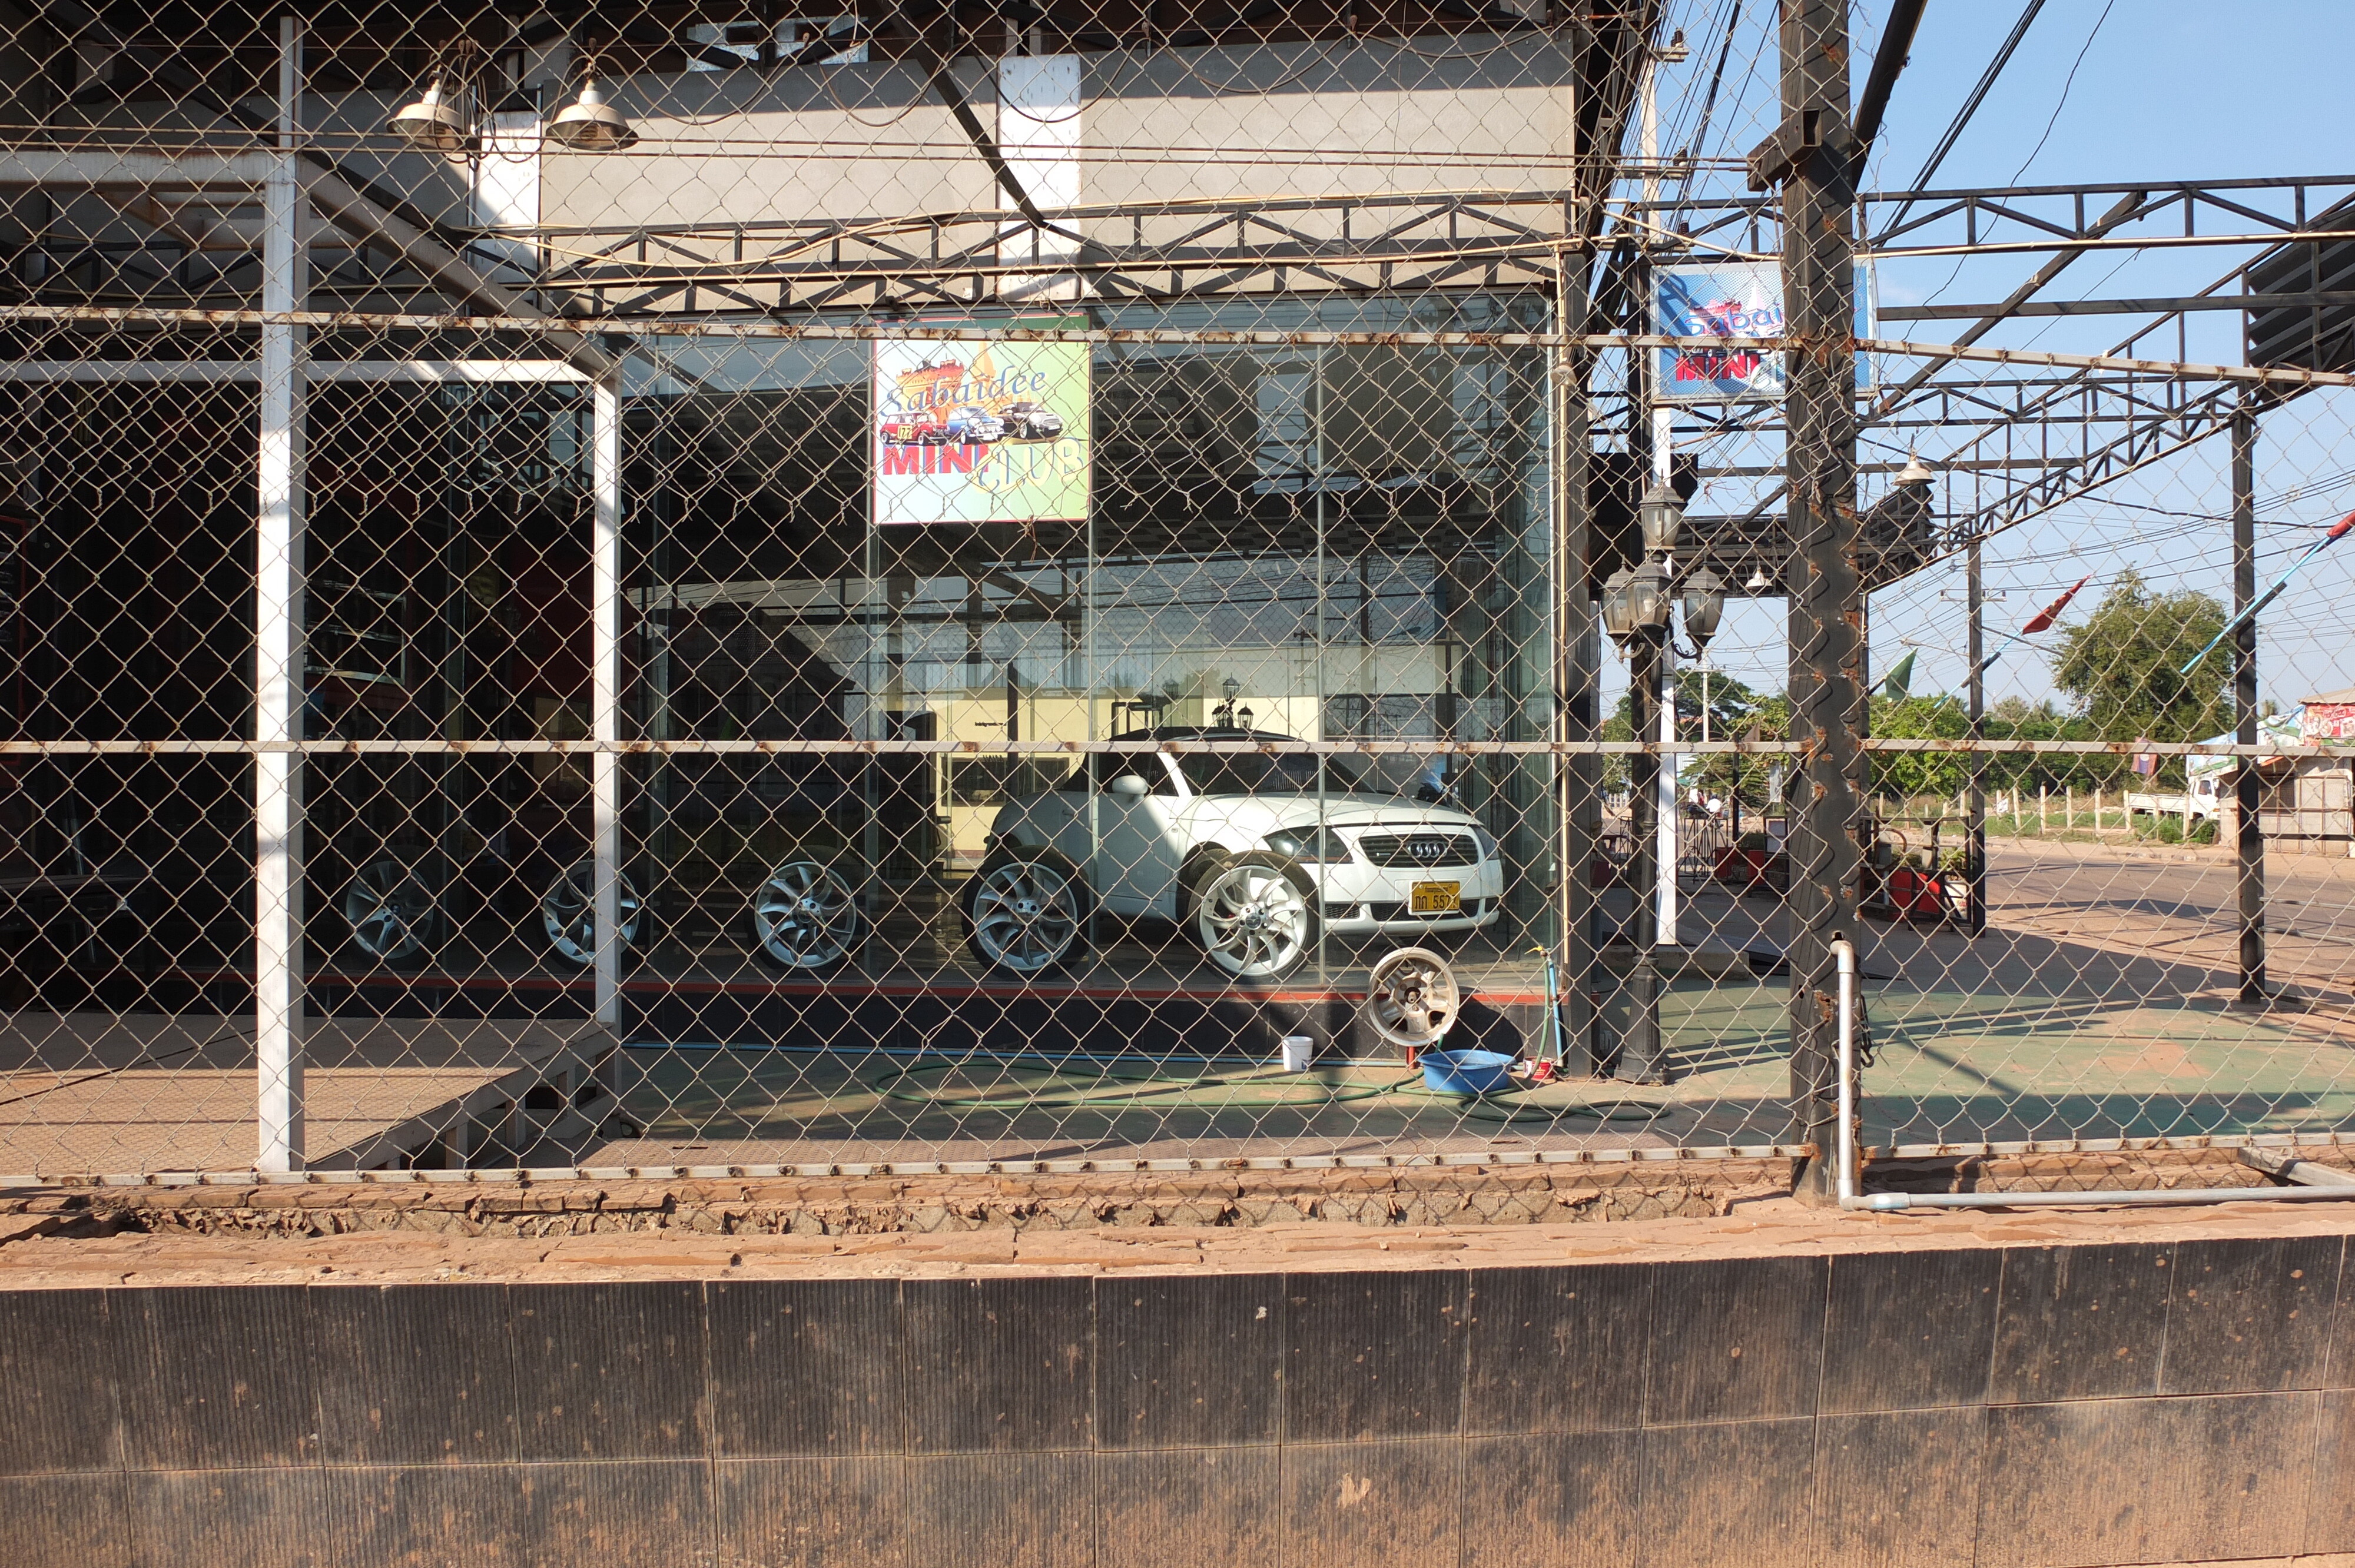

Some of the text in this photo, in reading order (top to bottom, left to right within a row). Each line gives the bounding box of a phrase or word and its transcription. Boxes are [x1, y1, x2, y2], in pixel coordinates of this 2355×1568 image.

[1684, 303, 1783, 337] Sabai
[1676, 354, 1760, 381] MINI
[880, 366, 1048, 417] Sabaidee
[883, 437, 1083, 494] MINI CLUB
